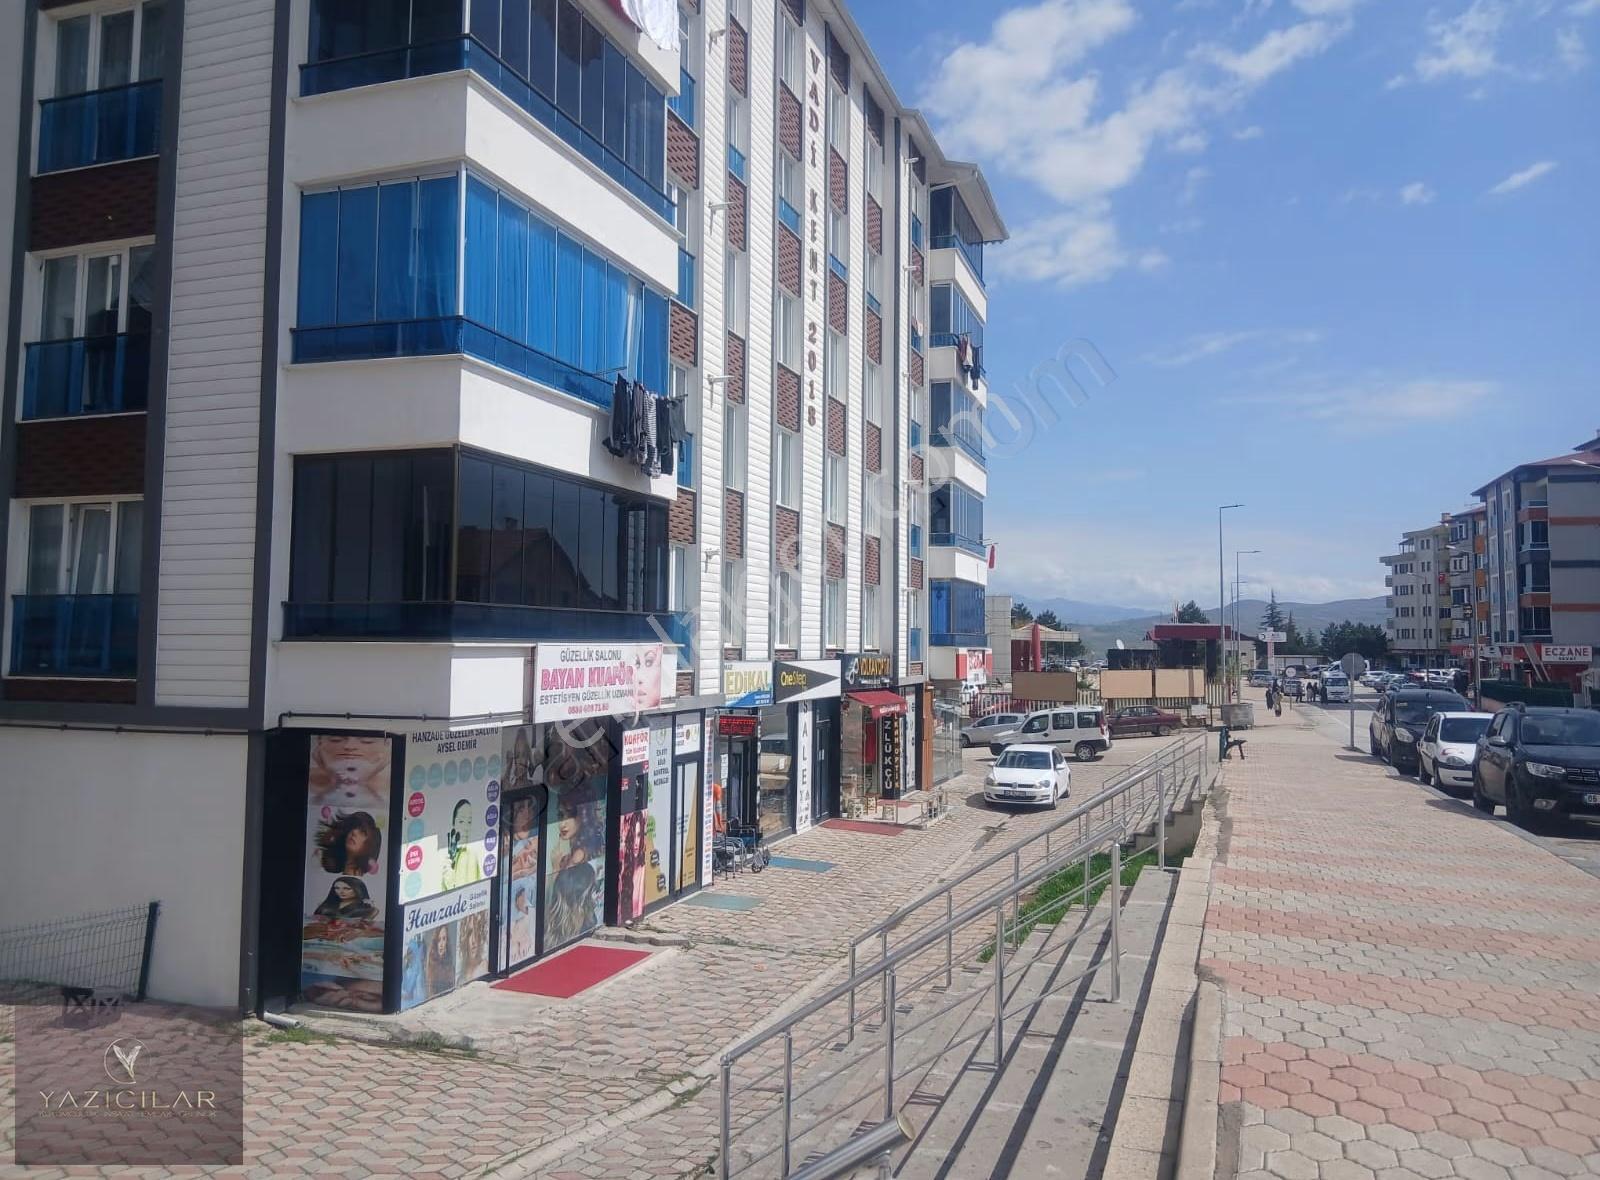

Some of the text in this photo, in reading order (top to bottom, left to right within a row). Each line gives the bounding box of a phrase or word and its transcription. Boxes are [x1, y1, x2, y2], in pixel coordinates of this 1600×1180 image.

[807, 47, 821, 428] VADİ KENT 2018
[560, 647, 622, 662] GÜZELLİK SALONU
[1545, 647, 1589, 657] ECZANE
[540, 661, 635, 690] BAYAN KUAFÖR
[539, 691, 581, 705] ESTETİSYEN
[581, 688, 611, 701] GÜZELLİK
[437, 738, 477, 753] AYSEL DEMİR
[624, 731, 648, 746] KUAFÖR
[405, 894, 468, 931] Hanzade
